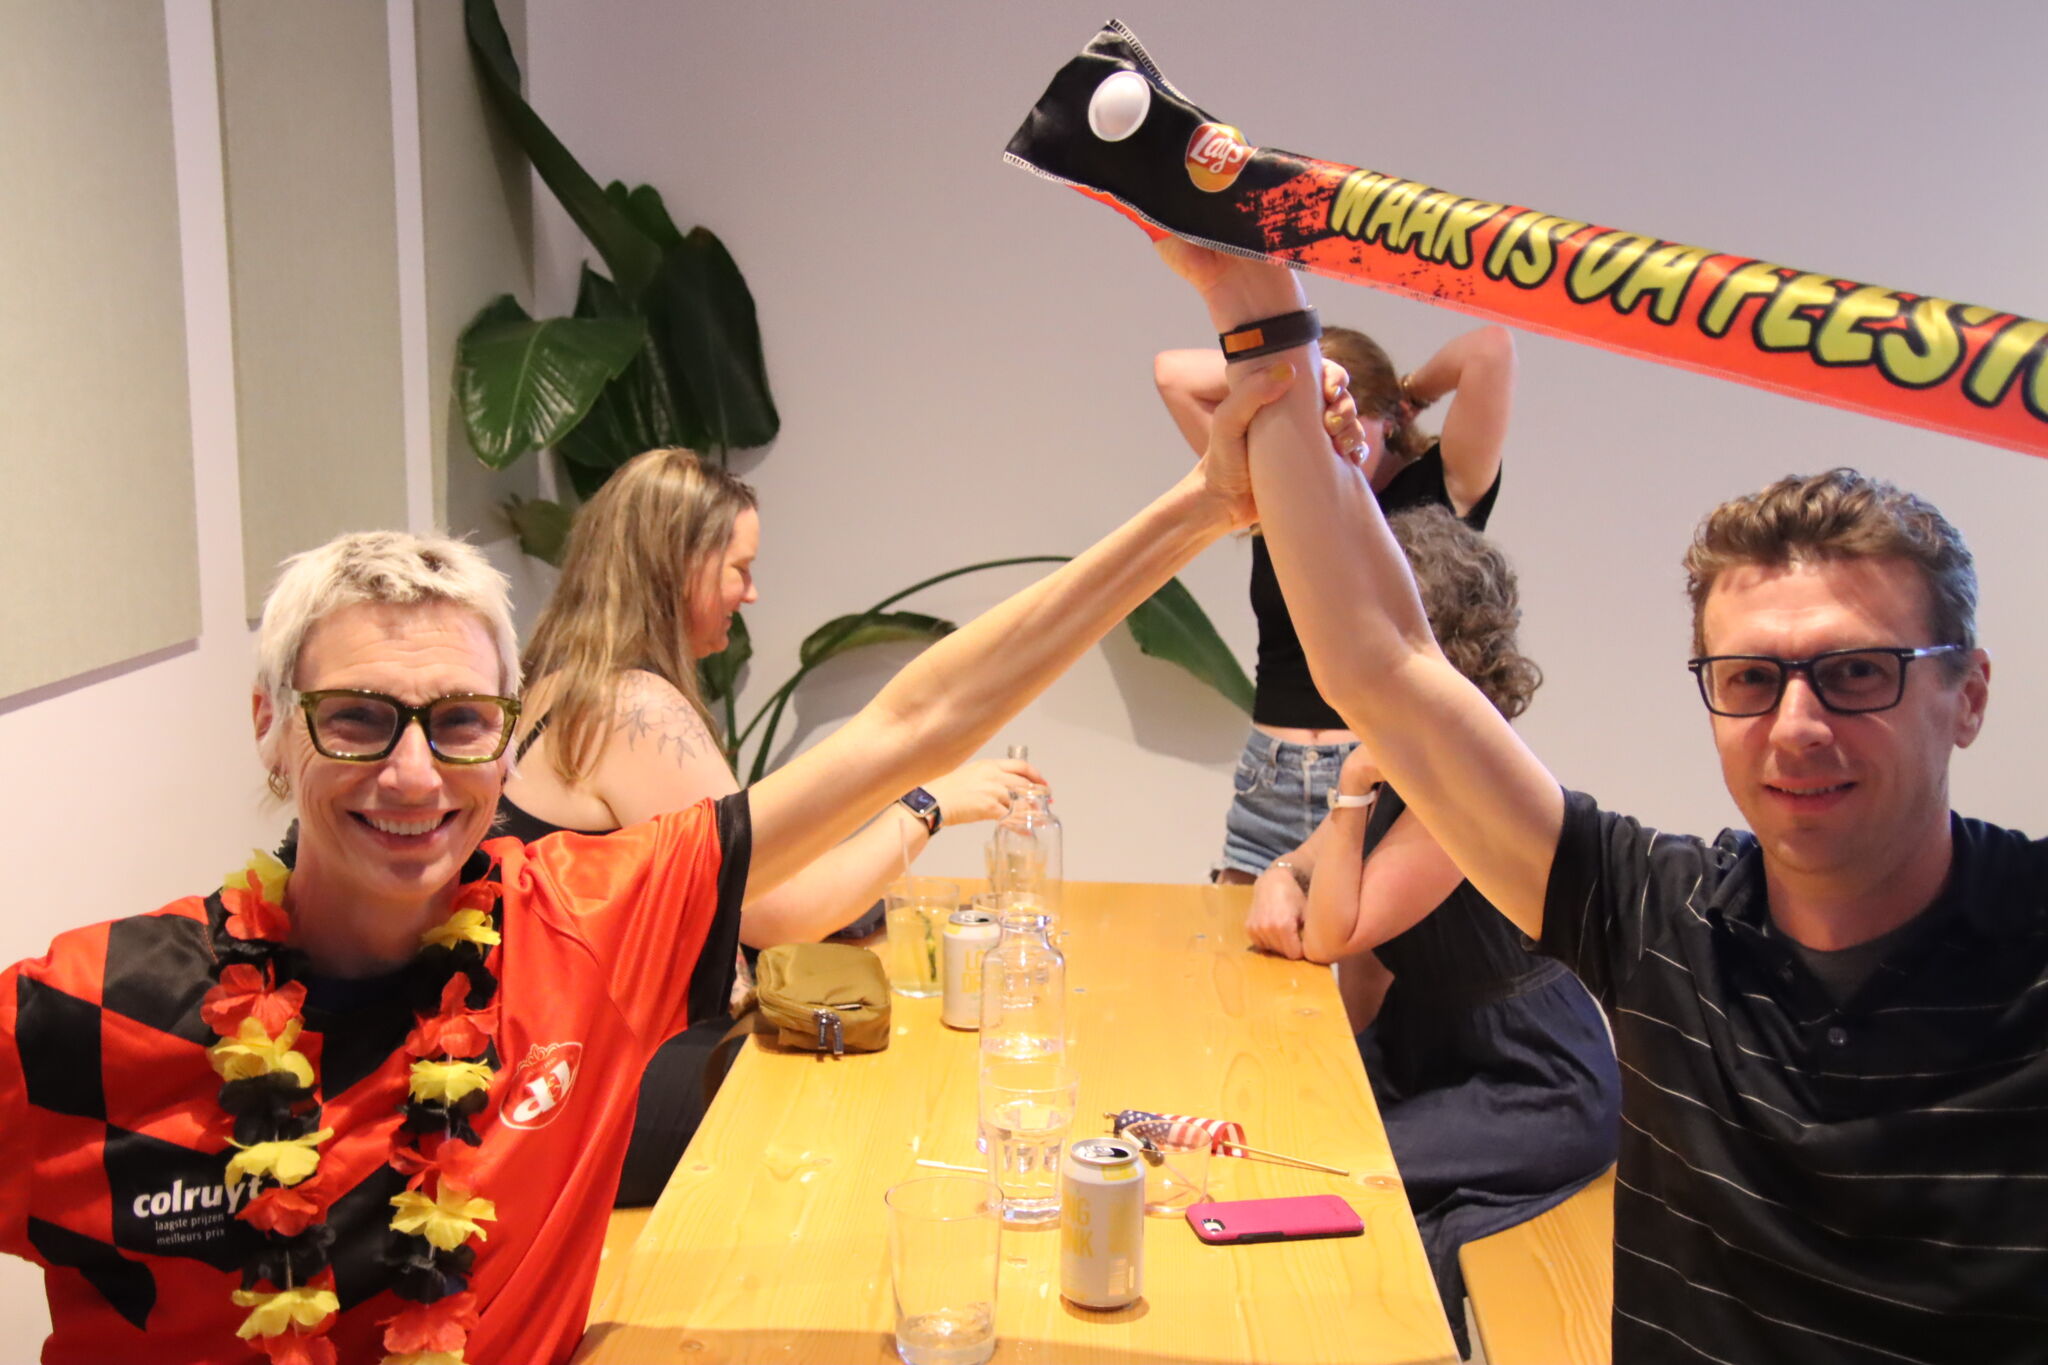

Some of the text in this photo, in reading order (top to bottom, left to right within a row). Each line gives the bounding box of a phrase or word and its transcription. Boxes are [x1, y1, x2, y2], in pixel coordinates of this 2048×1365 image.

[1483, 211, 1593, 290] IS
[1697, 260, 2048, 424] FEEST
[133, 1178, 263, 1218] colruyt
[154, 1212, 225, 1232] laagste prijzen
[156, 1227, 226, 1246] meilleurs prix
